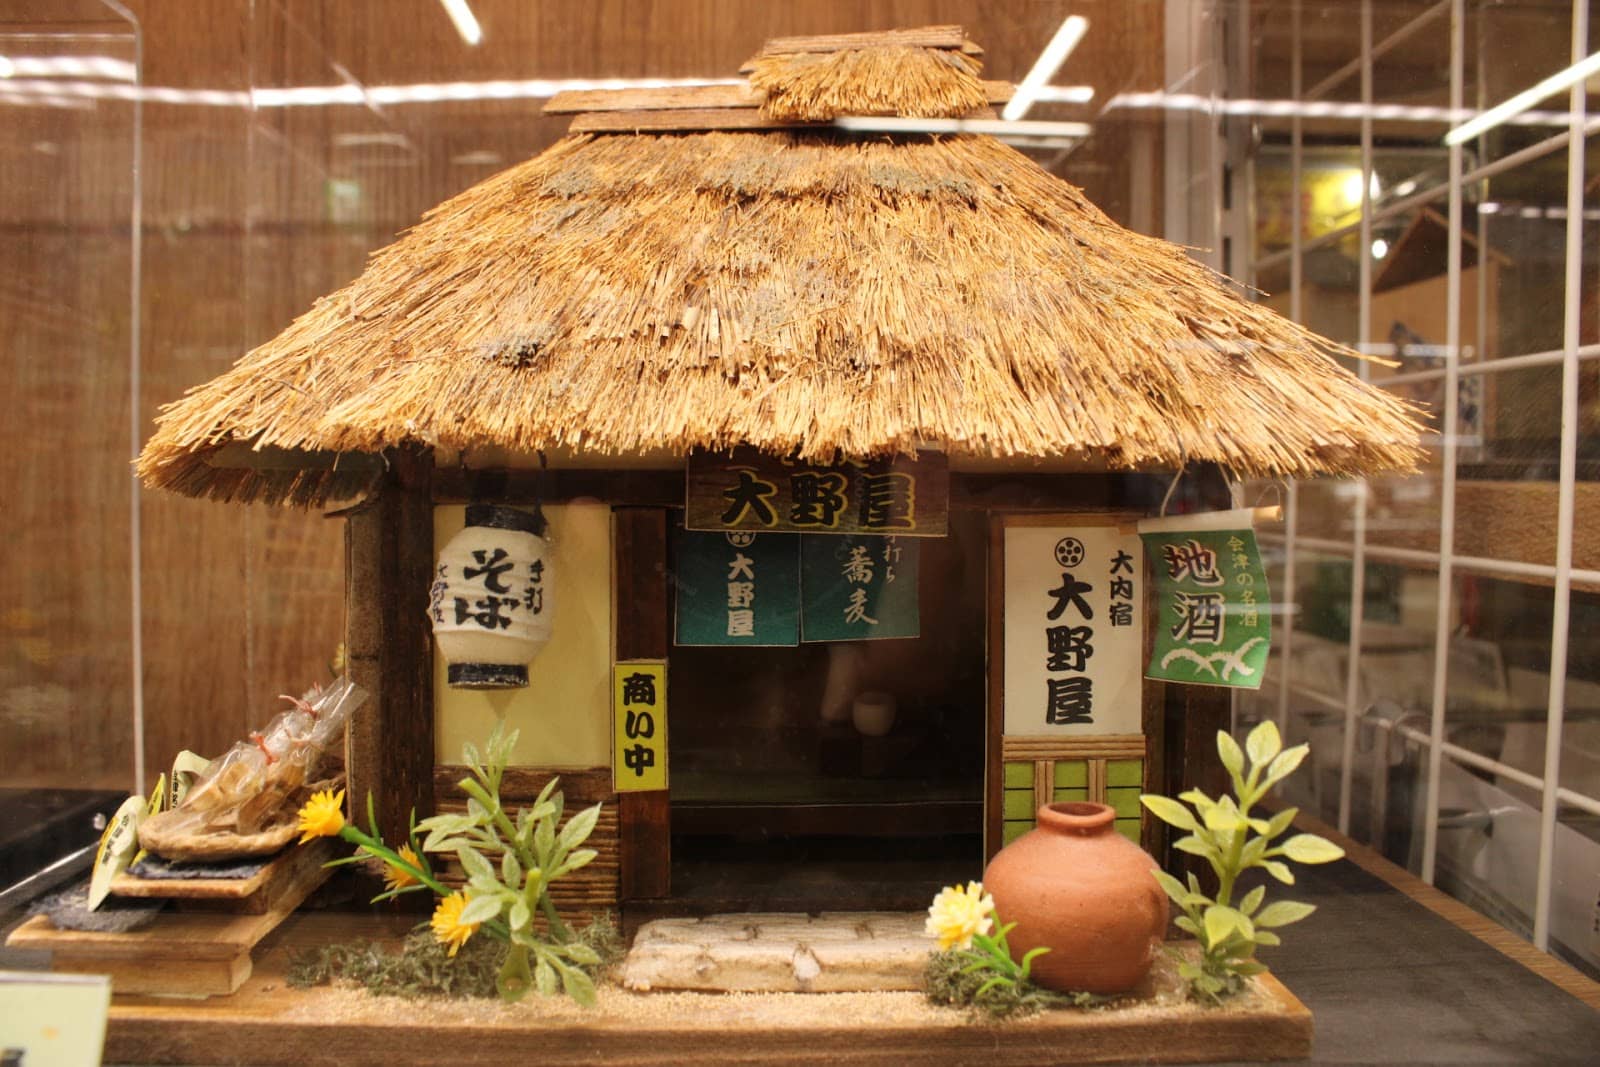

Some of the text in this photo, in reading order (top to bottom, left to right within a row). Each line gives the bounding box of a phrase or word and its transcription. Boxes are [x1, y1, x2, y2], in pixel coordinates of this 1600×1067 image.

[720, 470, 916, 530] 大野屋
[454, 548, 519, 629] そば
[727, 553, 755, 637] 大野屋
[841, 546, 879, 625] 蕎麦
[1109, 550, 1134, 627] 大内宿
[1162, 539, 1224, 645] 地酒
[1046, 572, 1094, 725] 大野屋
[623, 672, 656, 776] 商い中
